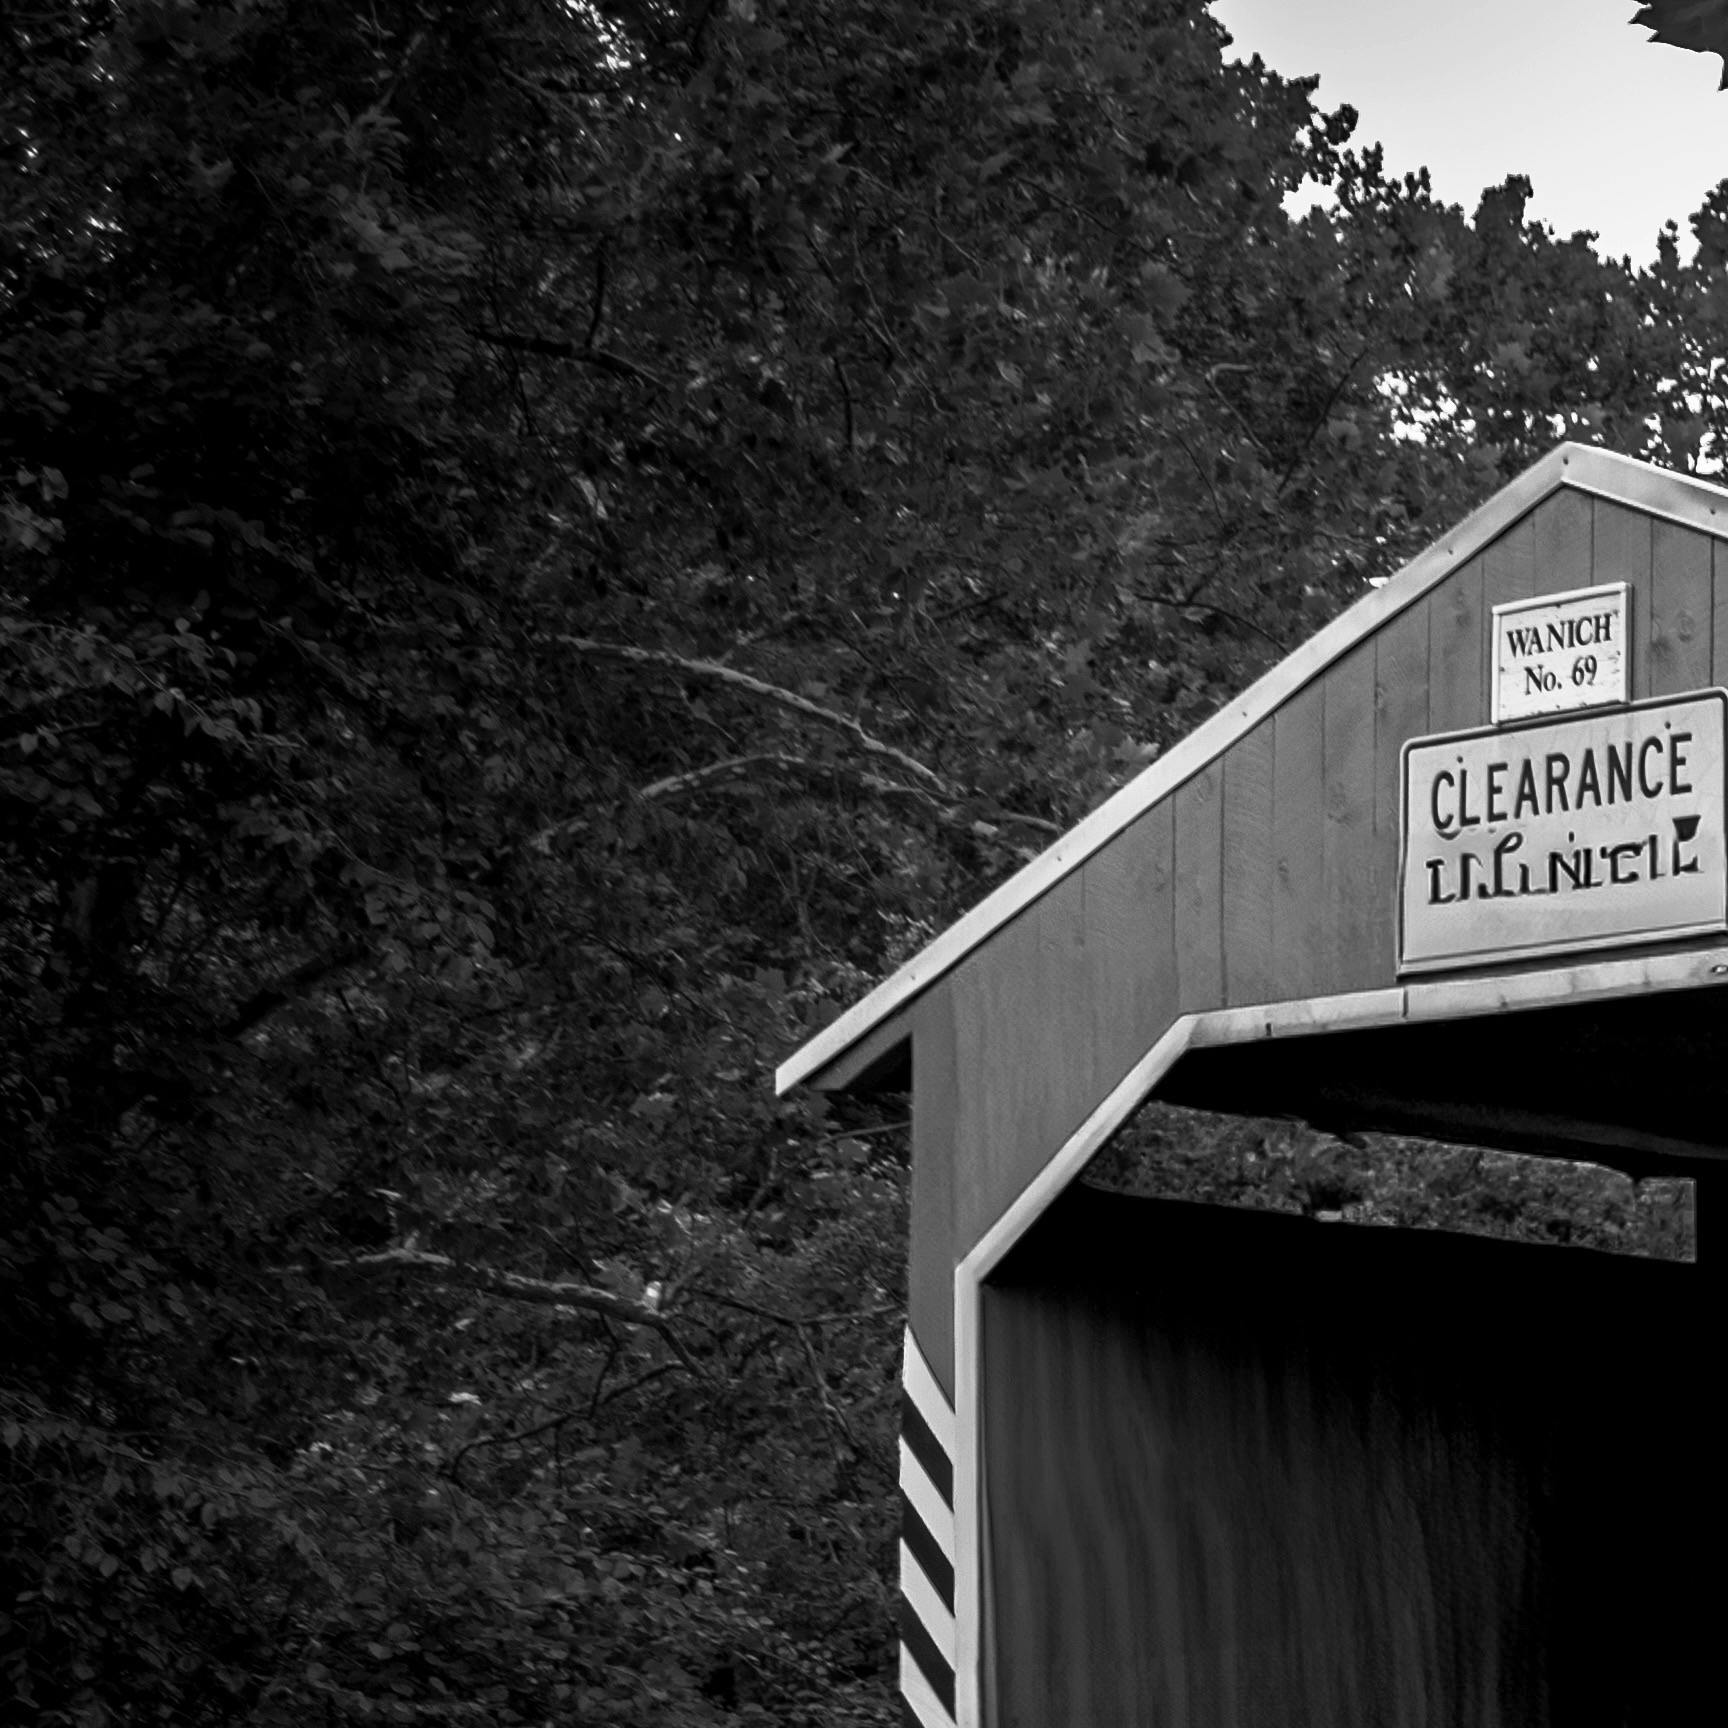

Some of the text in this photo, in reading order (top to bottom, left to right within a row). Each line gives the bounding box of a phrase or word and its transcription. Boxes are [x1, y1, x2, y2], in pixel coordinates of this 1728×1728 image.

[1506, 613, 1612, 658] WANICH
[1524, 655, 1598, 695] No. 69
[1431, 732, 1693, 830] CLEARANCE
